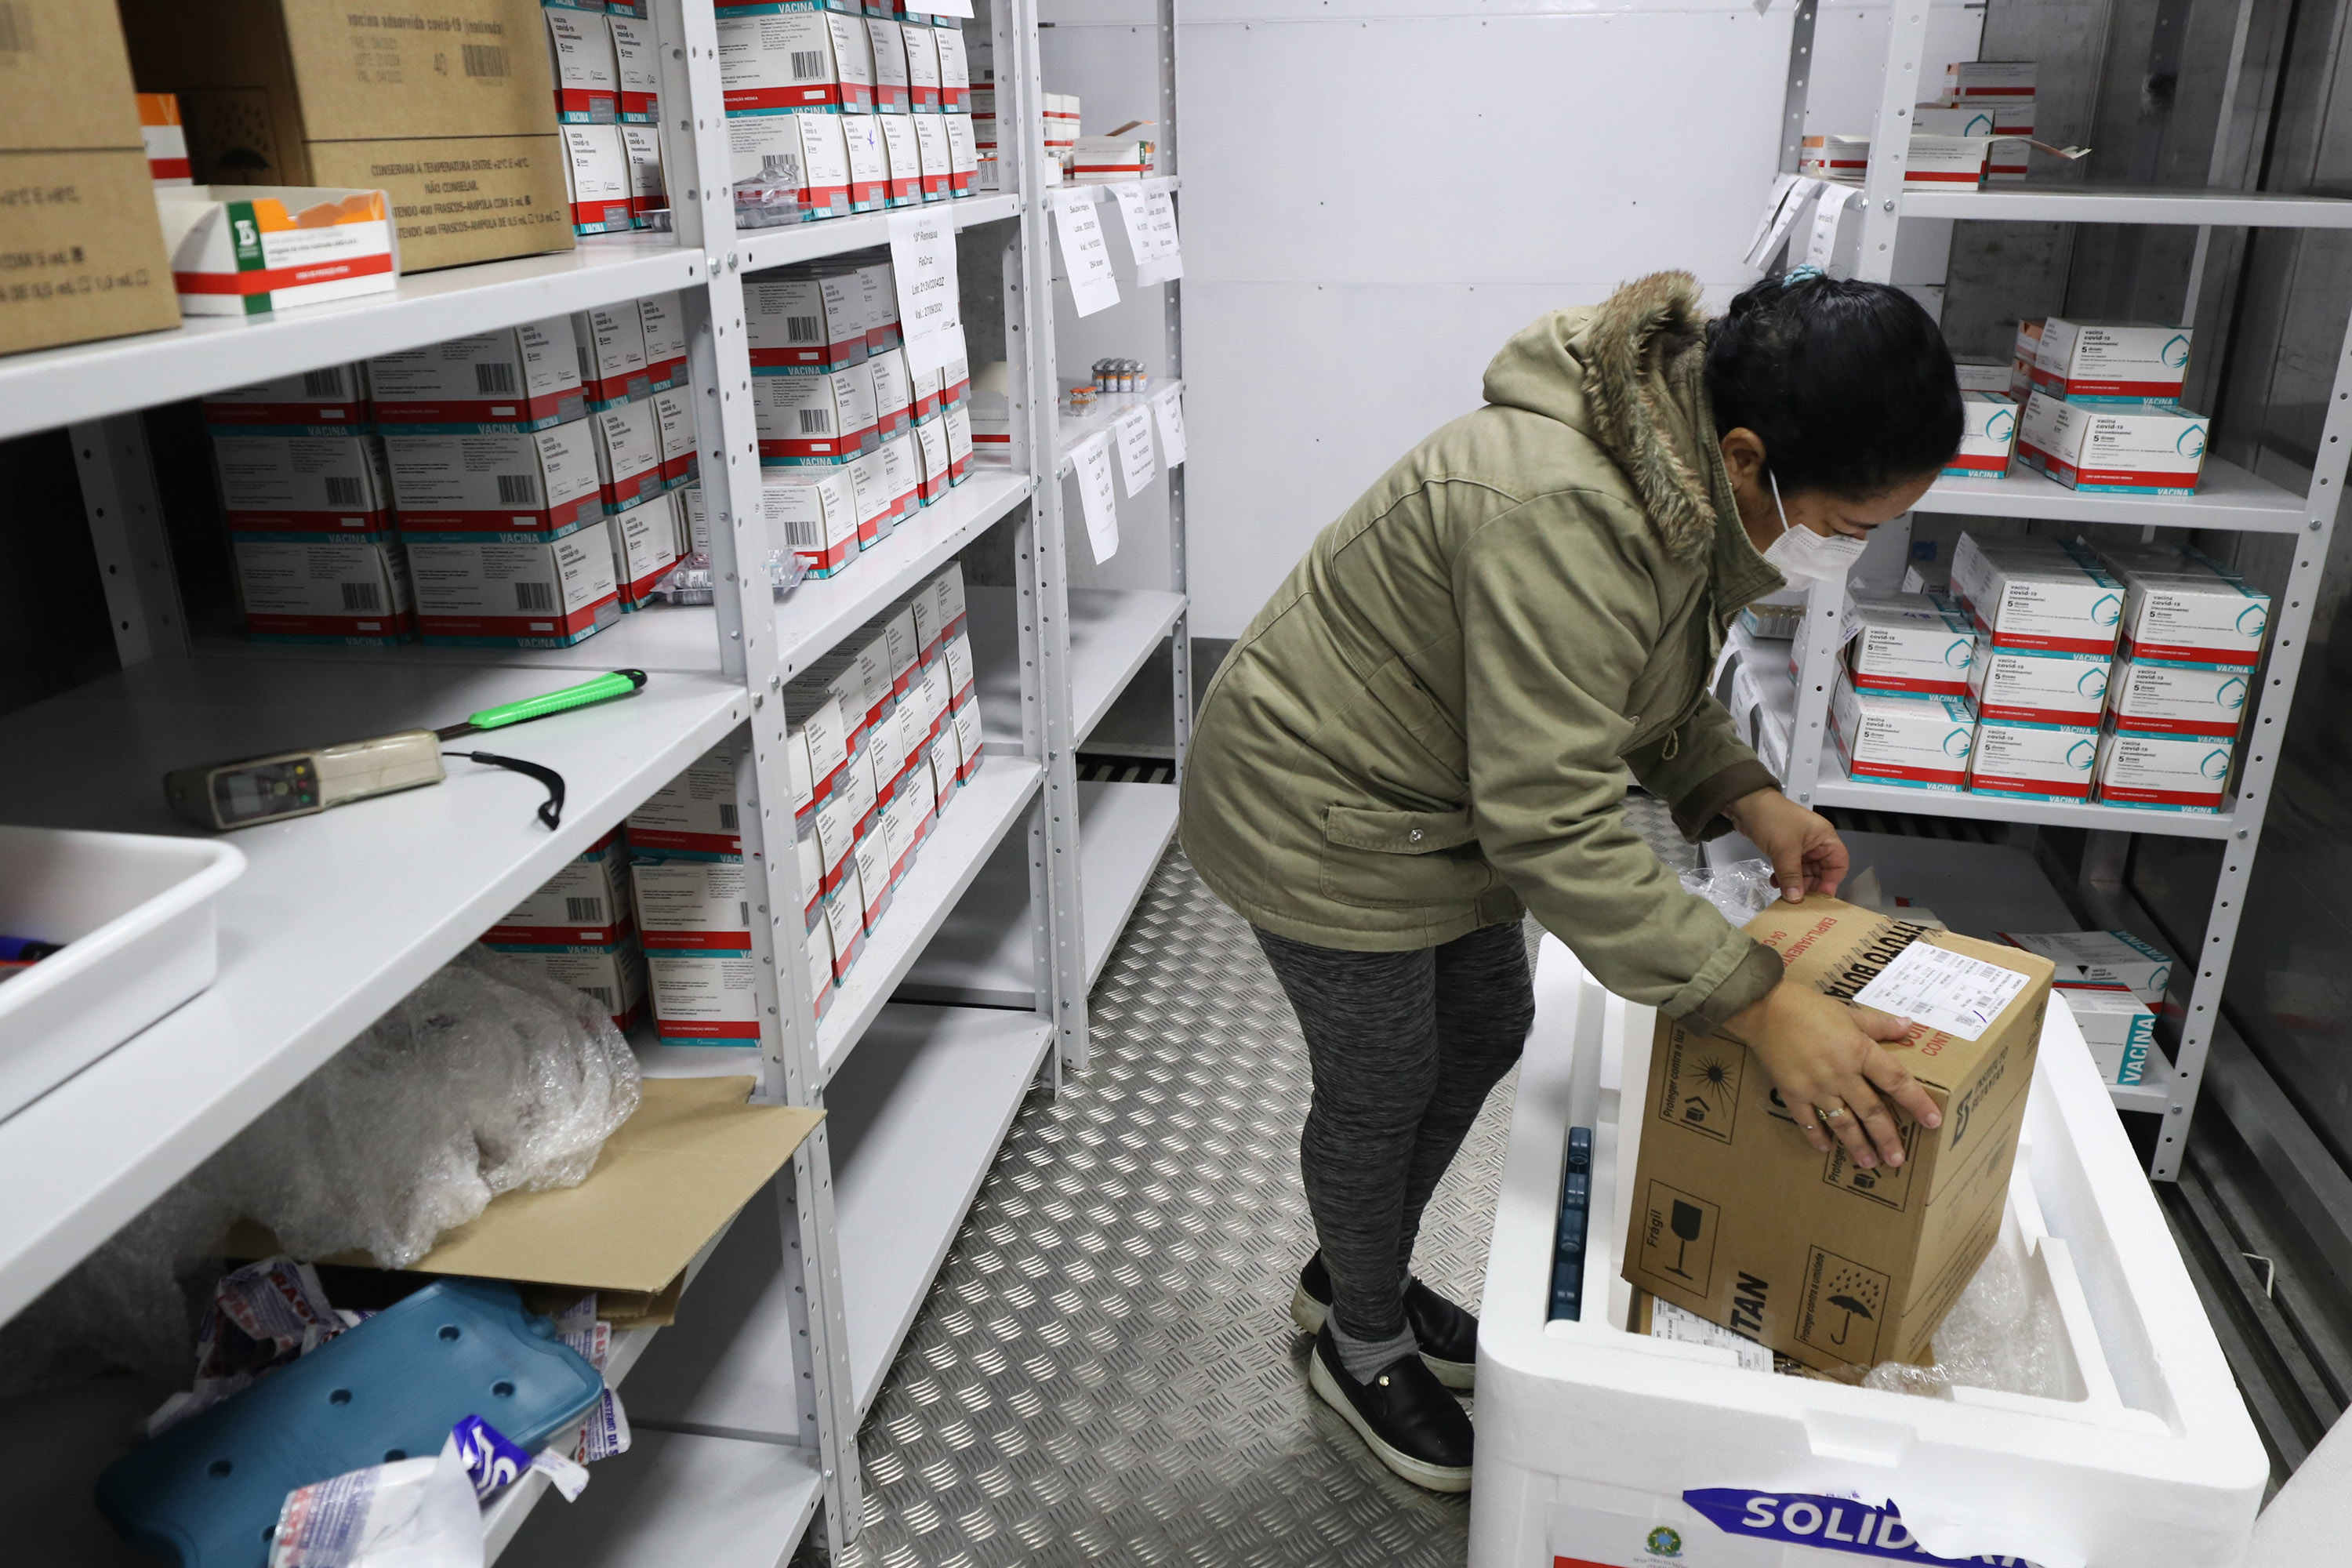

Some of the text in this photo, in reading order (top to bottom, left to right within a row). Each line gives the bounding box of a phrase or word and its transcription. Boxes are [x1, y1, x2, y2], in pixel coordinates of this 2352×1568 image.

[779, 2, 815, 13] VACINA
[792, 106, 828, 114] VACINA
[371, 162, 414, 176] CONSERVAR
[423, 159, 471, 173] TEMPERATURA
[473, 159, 492, 171] ENTRE
[424, 180, 441, 194] NÃO
[394, 205, 418, 218] TENDO
[493, 198, 509, 209] COM
[397, 226, 422, 239] TENDO
[499, 217, 507, 228] DE
[788, 366, 821, 376] VACINA
[307, 426, 348, 437] VACINA
[477, 423, 519, 434] VACINA
[800, 457, 833, 466] VACINA
[1968, 470, 1998, 479] VACINA
[328, 533, 367, 544] VACINA
[499, 533, 539, 543] VACINA
[345, 637, 383, 647] VACINA
[517, 638, 556, 648] VACINA
[2073, 654, 2105, 662] VACINA
[2216, 665, 2249, 673] VACINA
[1929, 695, 1958, 703] VACINA
[1926, 782, 1957, 792] VACINA
[2049, 796, 2080, 804] VACINA
[720, 855, 742, 863] VACI
[567, 946, 604, 955] VACINA
[2117, 930, 2169, 961] VACINA
[1824, 963, 1882, 1006] BUTA
[1675, 1030, 1686, 1045] luz
[1922, 1030, 1954, 1057] CONT
[2123, 1017, 2156, 1083] VACINA
[1671, 1051, 1682, 1080] contra
[1663, 1077, 1679, 1118] Proteger
[1828, 1146, 1846, 1183] Proteger
[1647, 1209, 1662, 1248] Frágil
[1813, 1253, 1824, 1284] umidade
[1809, 1288, 1819, 1313] contra
[1800, 1306, 1815, 1342] Proteger
[608, 1434, 617, 1446] DA
